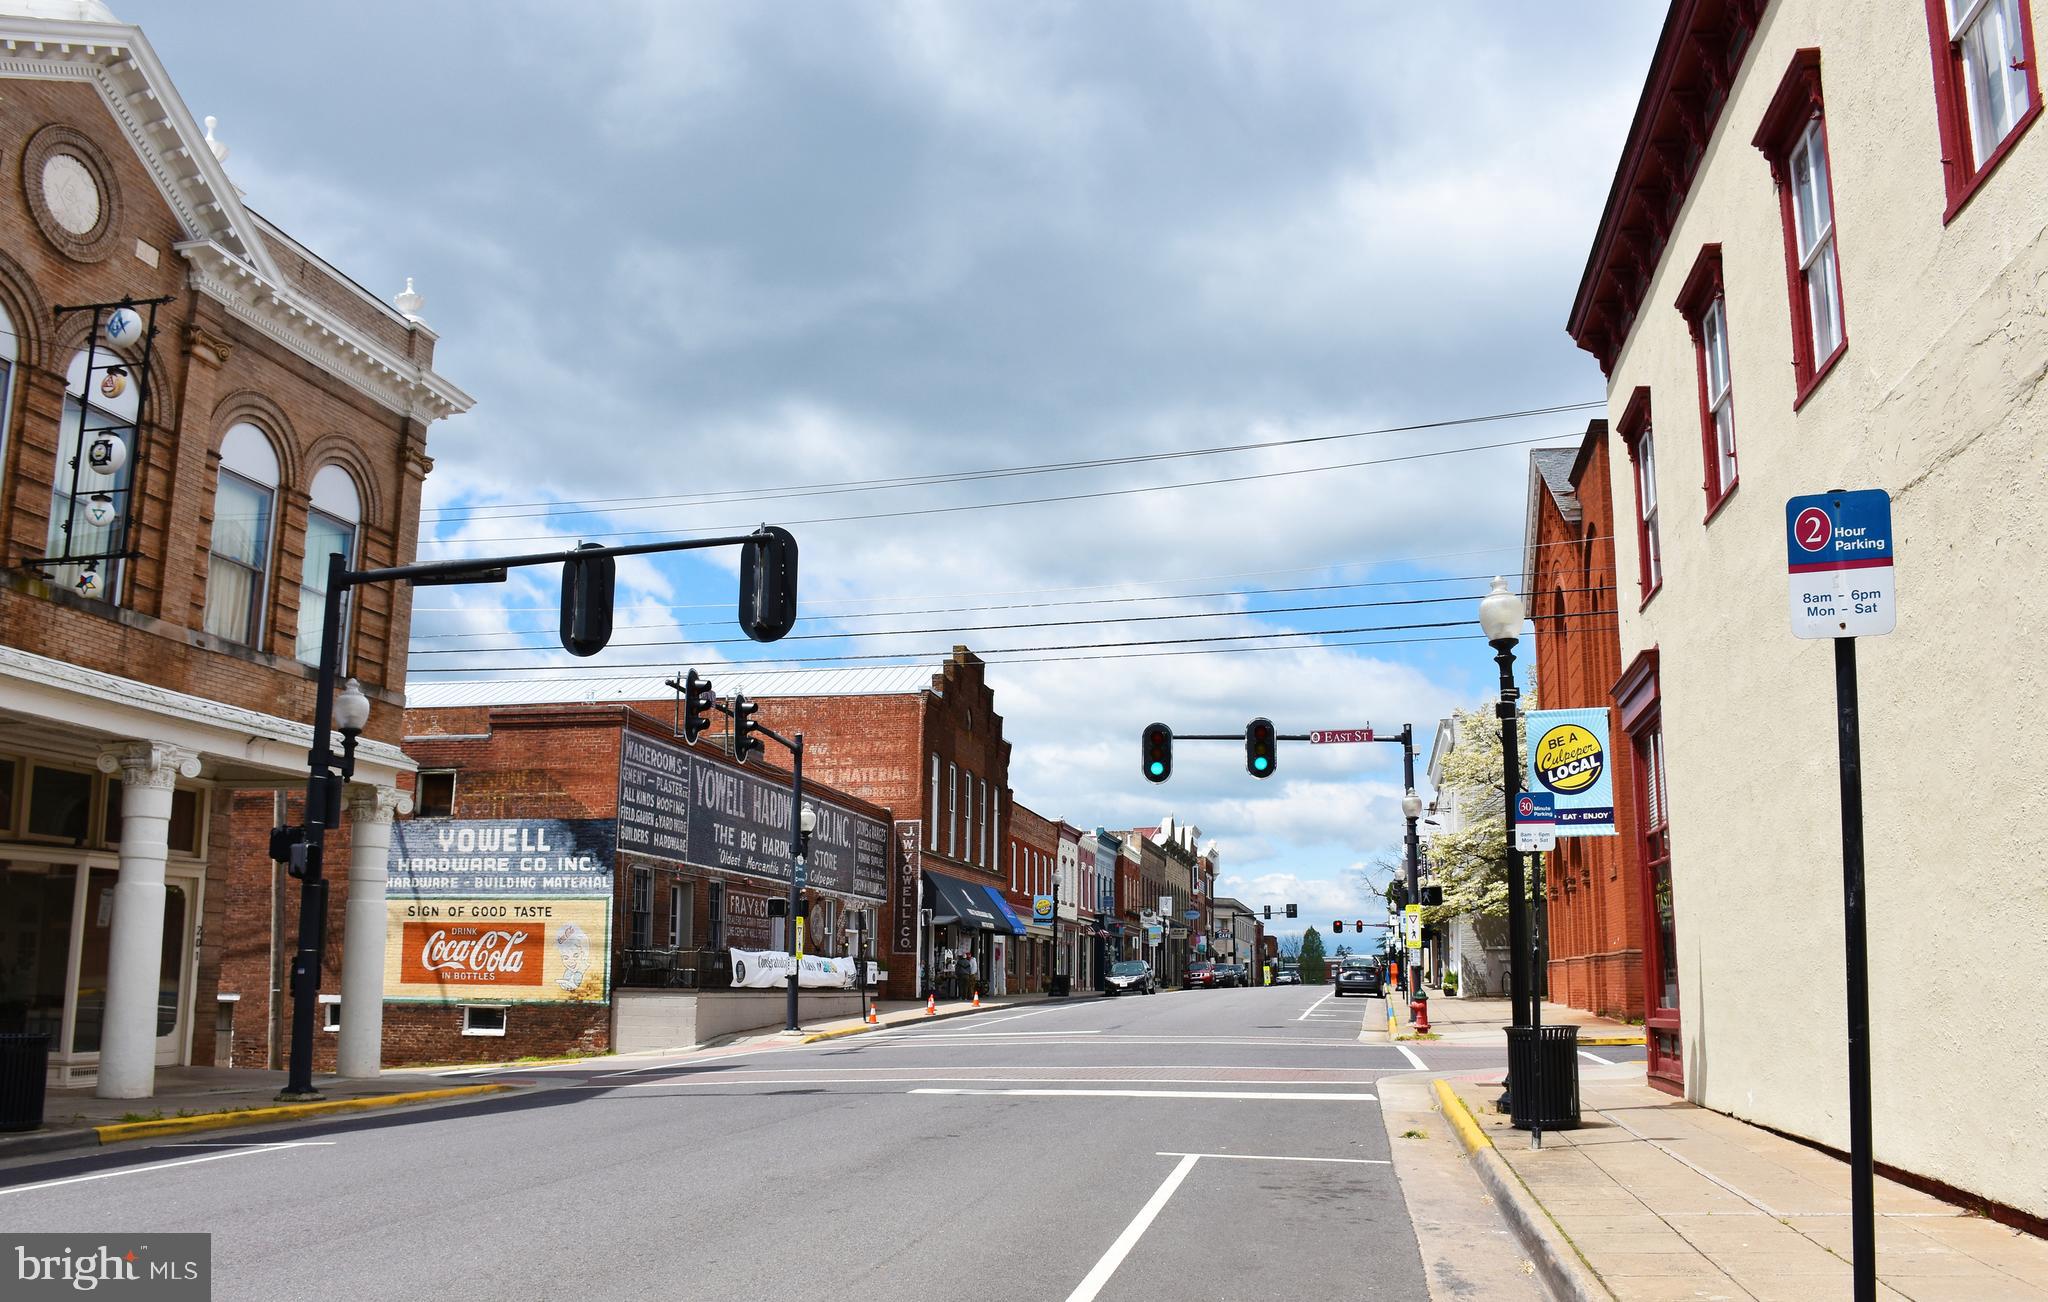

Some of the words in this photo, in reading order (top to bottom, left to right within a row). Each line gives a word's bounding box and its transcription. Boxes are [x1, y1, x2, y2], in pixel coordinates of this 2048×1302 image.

[1805, 516, 1821, 542] 2
[1835, 527, 1865, 537] Hour
[1836, 539, 1884, 551] Parking
[1803, 593, 1832, 603] 8am
[1851, 589, 1881, 602] 6pm
[1807, 606, 1835, 617] Mon
[1855, 603, 1877, 613] Sat
[1548, 736, 1565, 750] BE
[1569, 732, 1578, 743] A
[1541, 744, 1598, 771] Culpeper
[1547, 755, 1600, 783] LOCAL
[656, 776, 682, 796] PLASTER
[623, 787, 635, 802] ALL
[636, 789, 655, 808] KINDS
[656, 795, 685, 816] ROOFING
[696, 765, 745, 818] YOWELL
[752, 784, 794, 832] HARDW
[1520, 802, 1532, 812] 30
[1583, 812, 1609, 820] ENJOY
[438, 828, 550, 852] YOWELL
[620, 825, 649, 845] BUILDERS
[653, 832, 688, 853] HARDWARE
[713, 823, 735, 847] THE
[740, 830, 757, 852] BIG
[762, 835, 793, 860] HARDW
[814, 849, 838, 871] STORE
[398, 857, 509, 872] HARDWARE
[520, 857, 552, 872] CO.
[558, 857, 596, 871] INC.
[746, 855, 779, 876] Mercantile
[385, 877, 459, 888] HARDWARE
[474, 877, 536, 889] BUILDING
[543, 877, 609, 888] MATERIAL
[407, 905, 439, 917] SIGN
[448, 906, 464, 916] OF
[471, 906, 507, 917] GOOD
[514, 906, 552, 917] TASTE
[451, 927, 478, 935] DRINK
[421, 929, 528, 973] Coca-Cola
